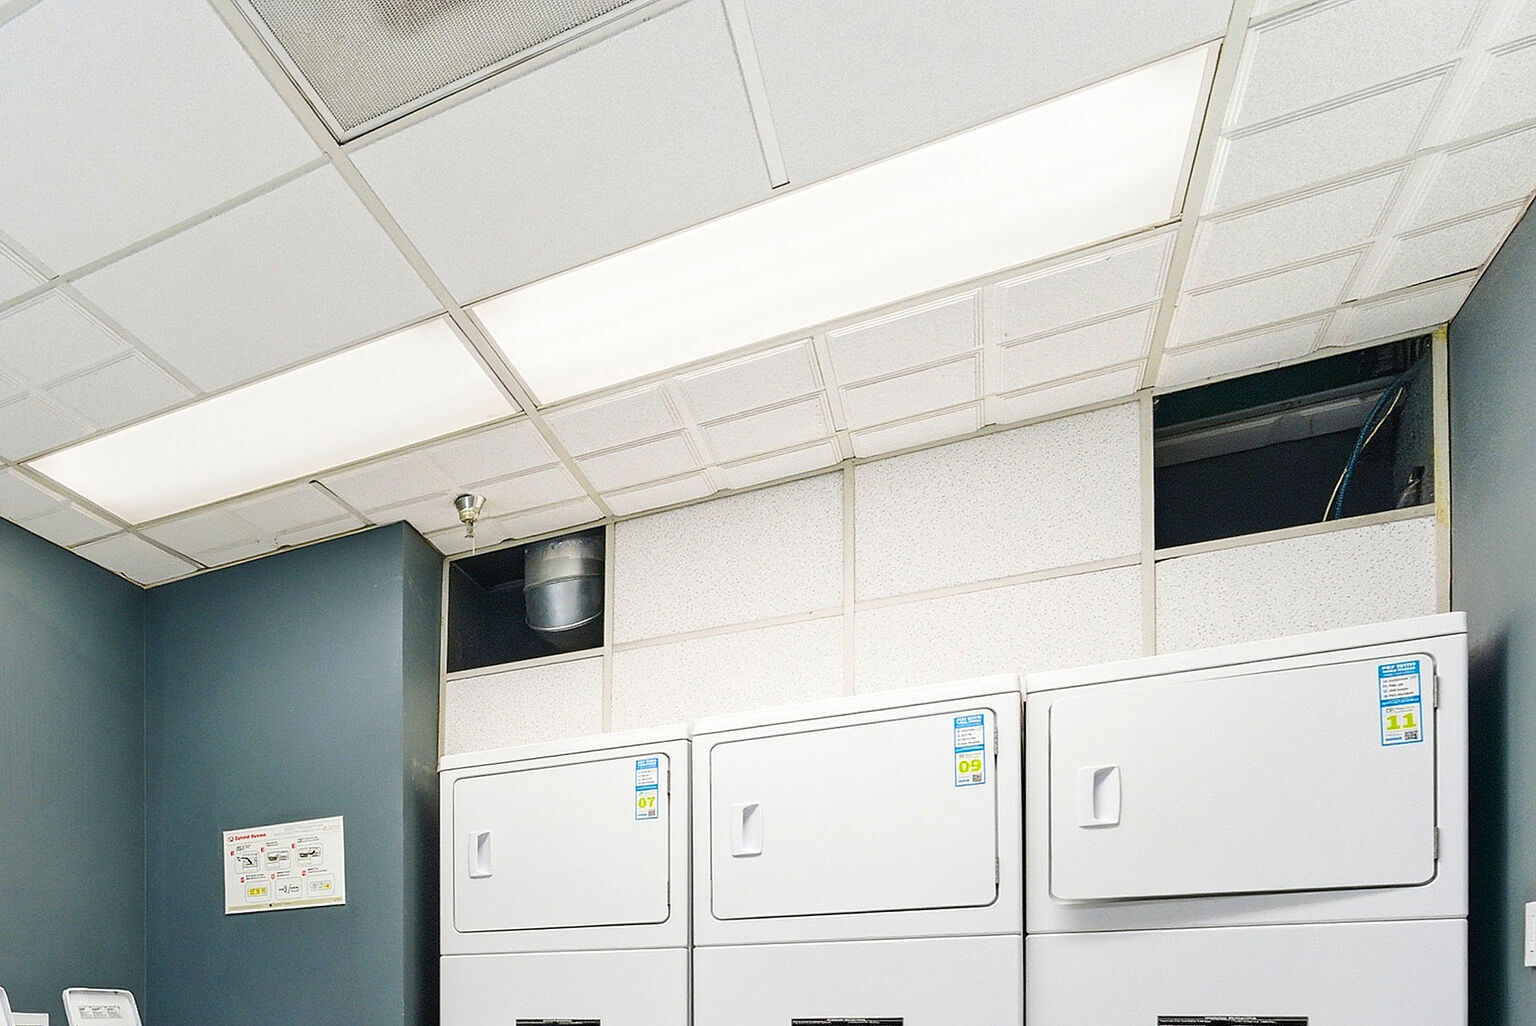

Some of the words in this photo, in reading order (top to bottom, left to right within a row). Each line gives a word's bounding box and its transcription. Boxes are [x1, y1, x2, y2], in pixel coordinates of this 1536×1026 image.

[1387, 713, 1416, 730] 11
[959, 759, 982, 773] 09
[638, 797, 655, 808] 07
